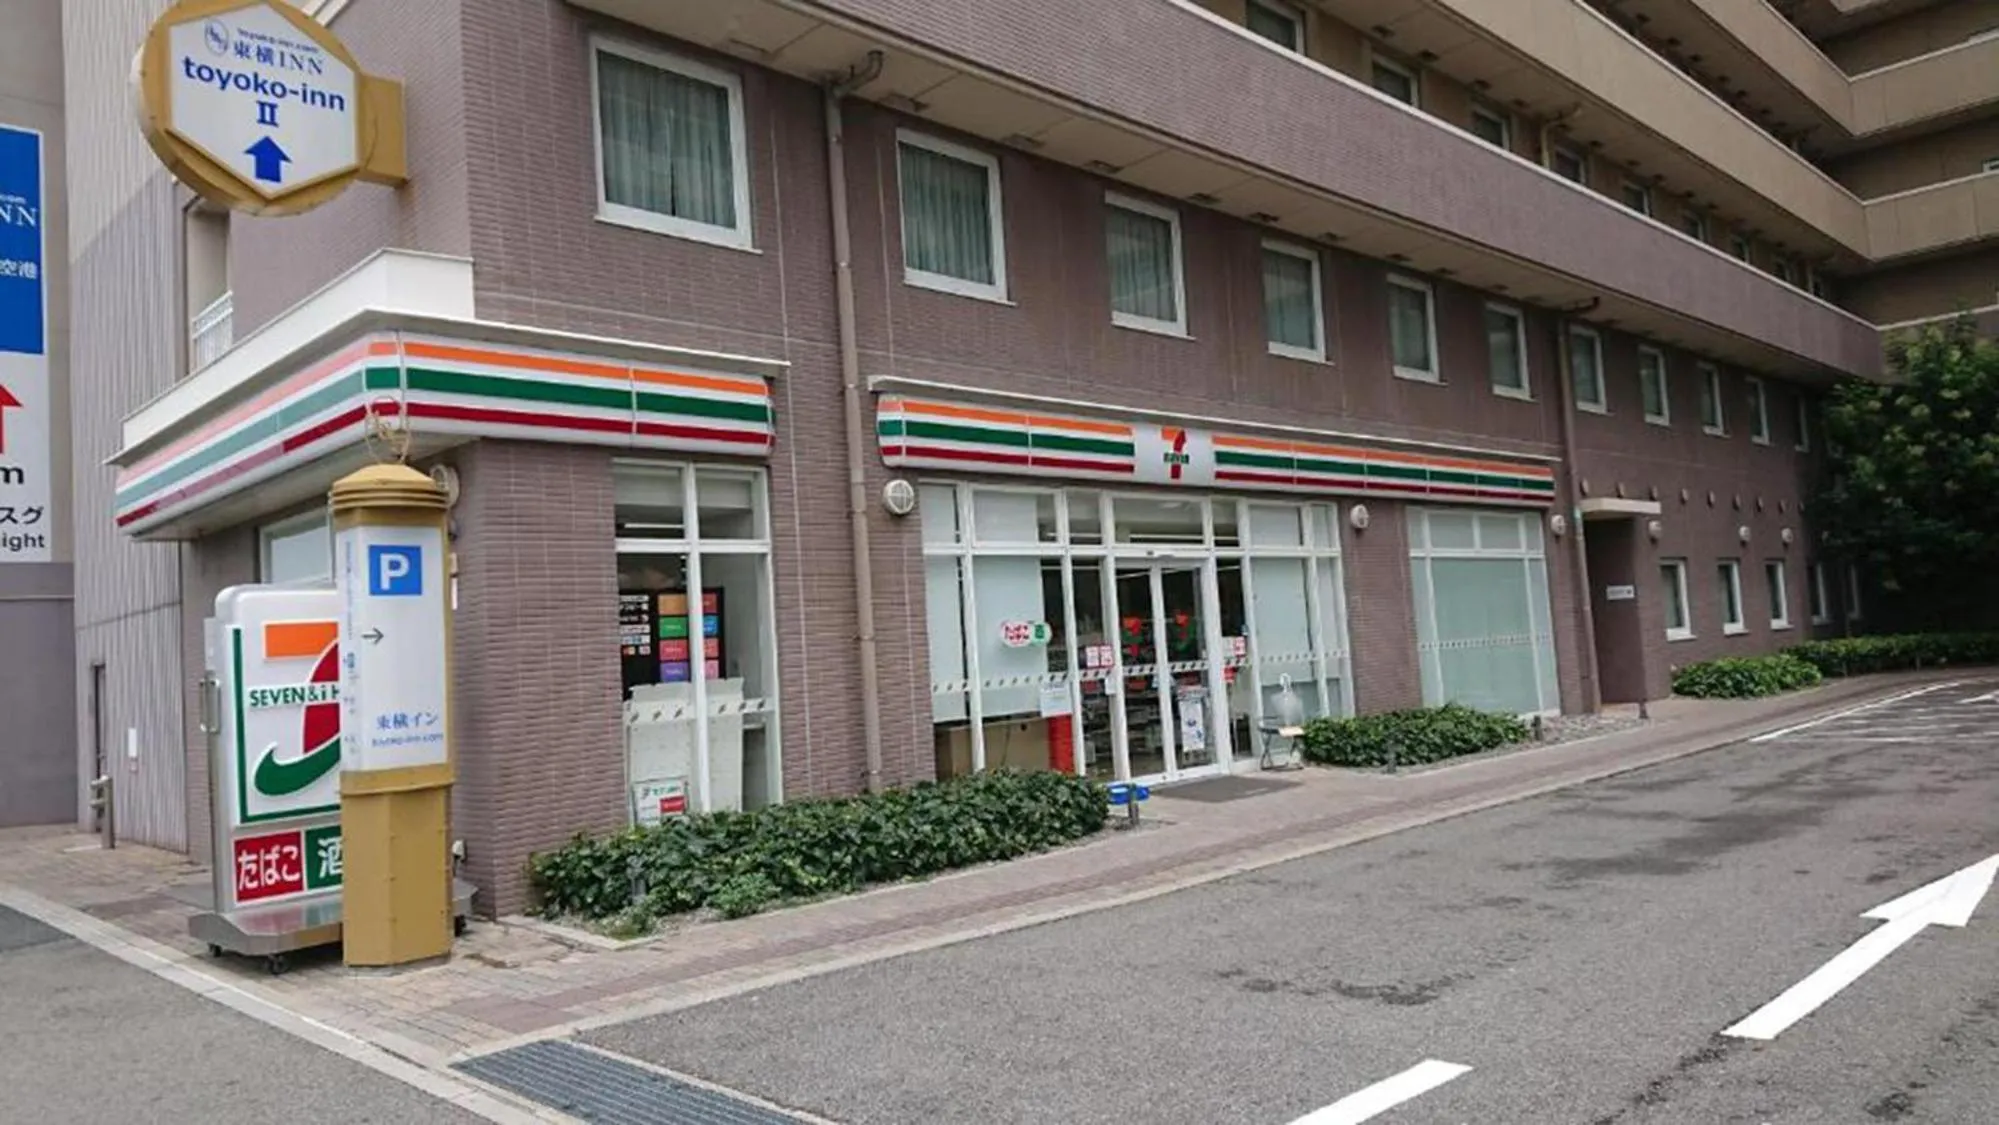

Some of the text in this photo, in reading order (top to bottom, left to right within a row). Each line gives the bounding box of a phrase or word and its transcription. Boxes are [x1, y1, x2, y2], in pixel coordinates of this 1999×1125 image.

[184, 55, 345, 112] toyoko-inn
[2, 533, 45, 552] ight
[379, 553, 410, 591] P
[238, 844, 301, 891] たばこ
